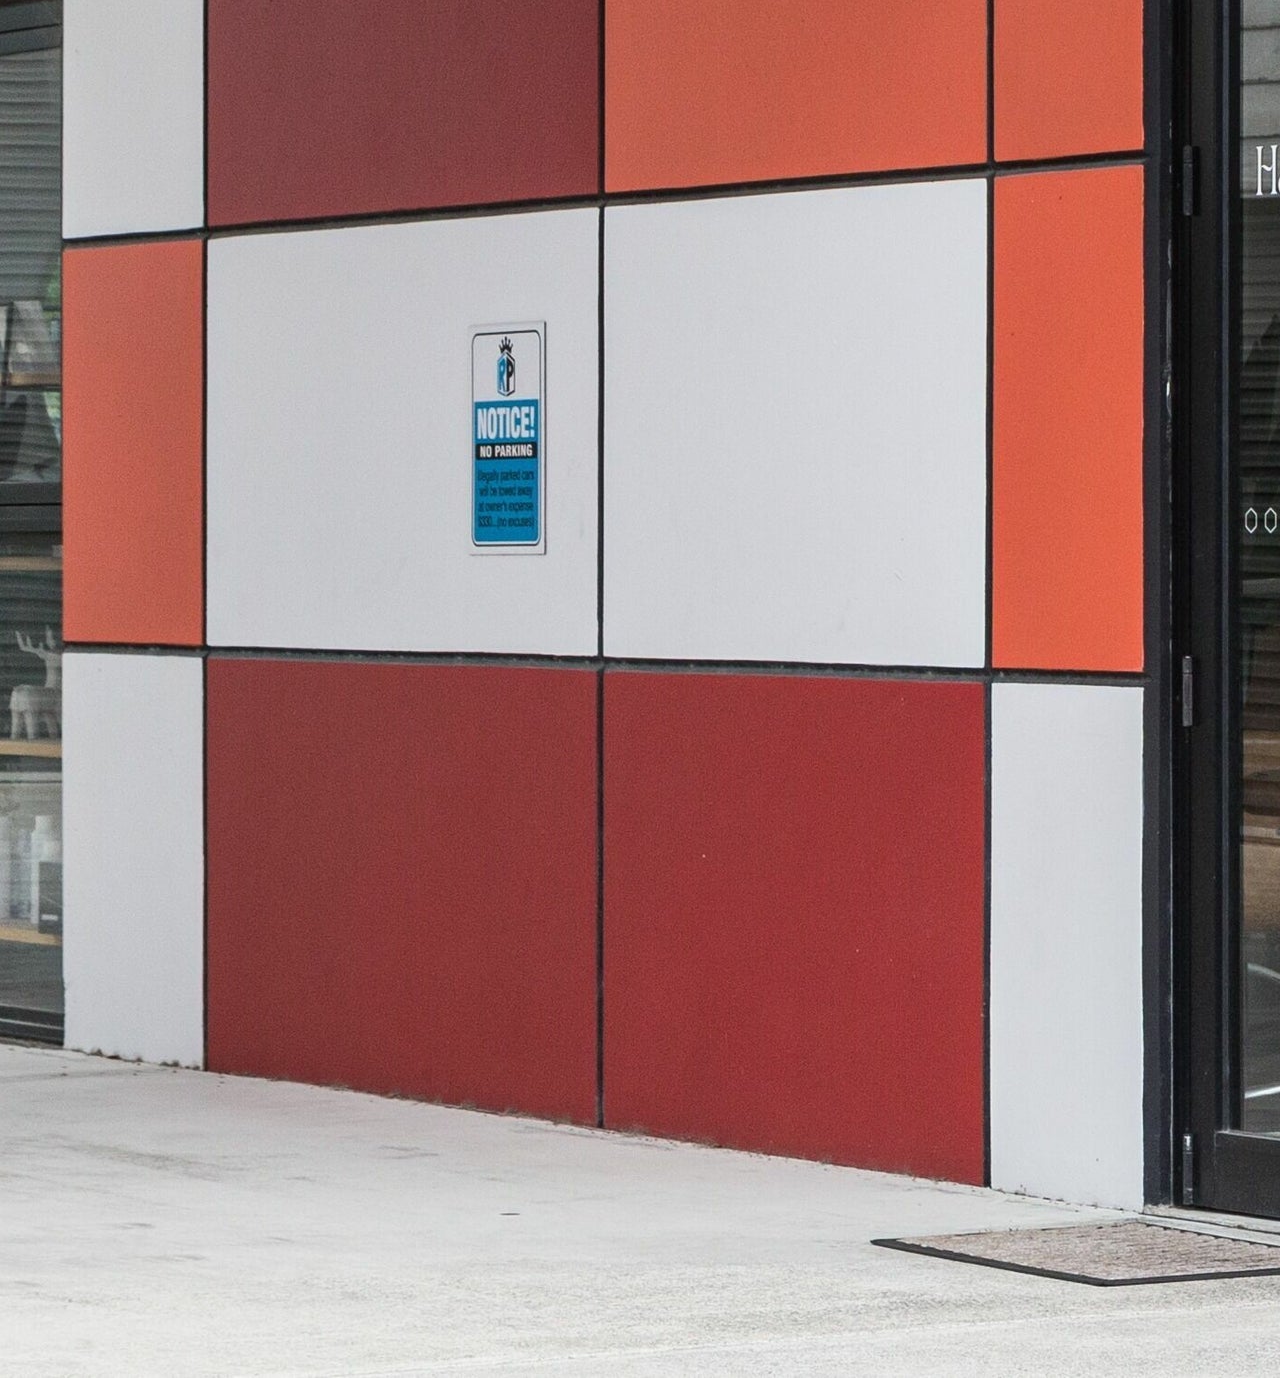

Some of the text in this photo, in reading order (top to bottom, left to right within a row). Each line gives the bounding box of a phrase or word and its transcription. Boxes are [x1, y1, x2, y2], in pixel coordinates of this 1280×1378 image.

[477, 406, 535, 440] NOTICE!
[480, 443, 533, 458] NO PARKING
